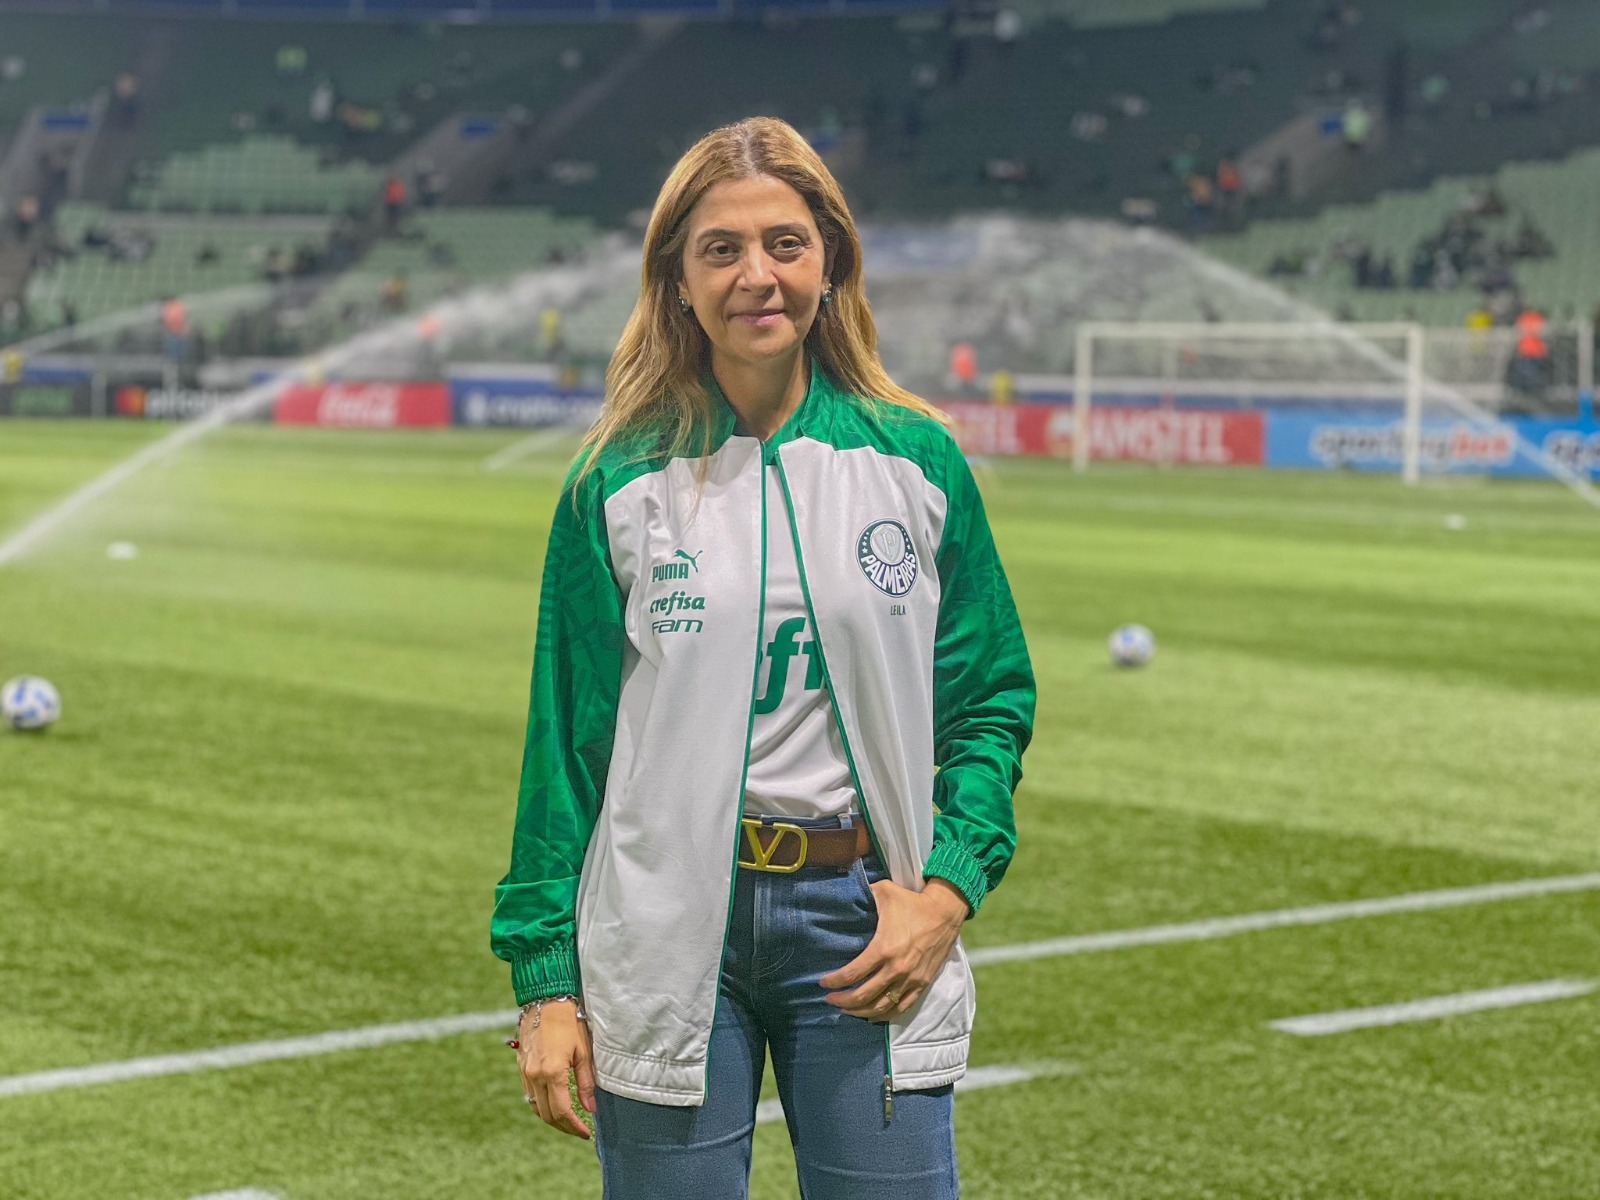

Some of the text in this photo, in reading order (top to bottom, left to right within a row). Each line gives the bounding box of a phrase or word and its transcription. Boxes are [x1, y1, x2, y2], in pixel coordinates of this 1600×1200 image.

[1310, 423, 1514, 472] sportngbet
[652, 563, 689, 582] PUMA
[860, 552, 916, 595] PALMEIRAS
[650, 590, 706, 616] crefisa
[890, 604, 906, 616] LEILA
[754, 616, 829, 715] fi
